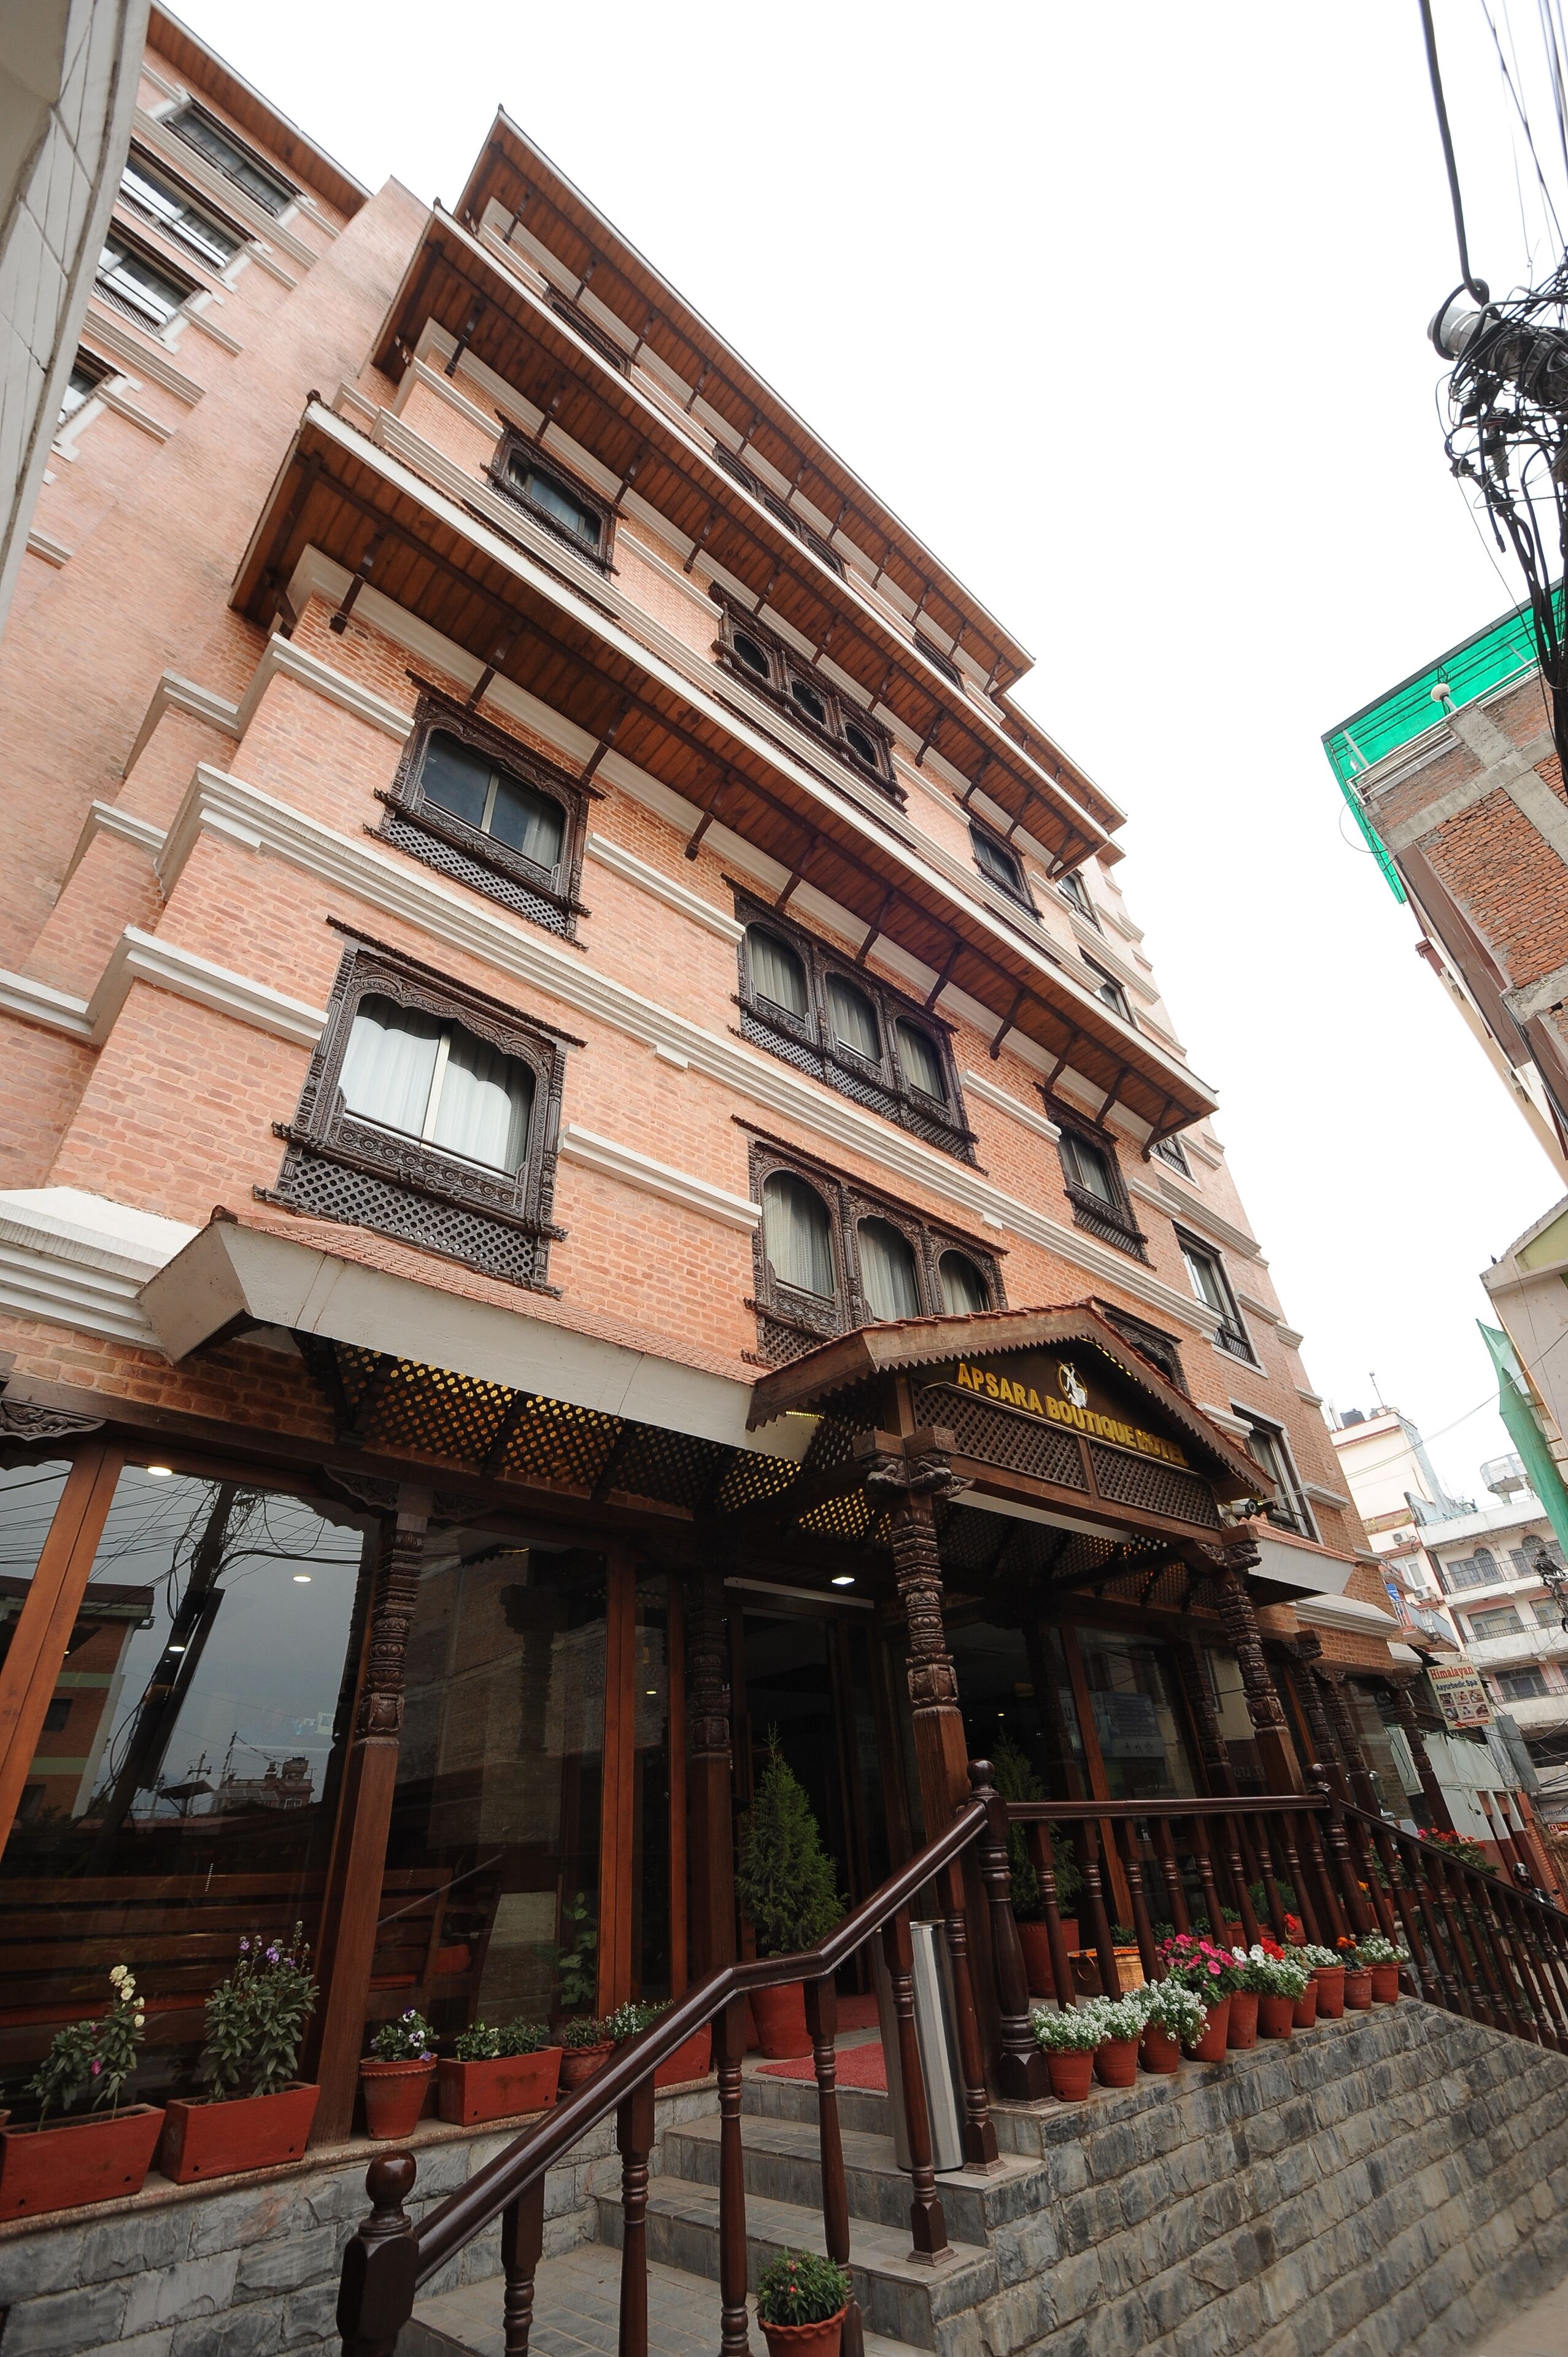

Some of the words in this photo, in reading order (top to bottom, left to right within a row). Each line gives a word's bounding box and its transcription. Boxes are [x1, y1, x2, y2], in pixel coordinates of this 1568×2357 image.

[957, 1362, 1045, 1415] APSARA
[1045, 1395, 1137, 1448] BOUTIQUE
[1134, 1428, 1189, 1468] HOTEL
[1429, 1666, 1475, 1680] Himalayan
